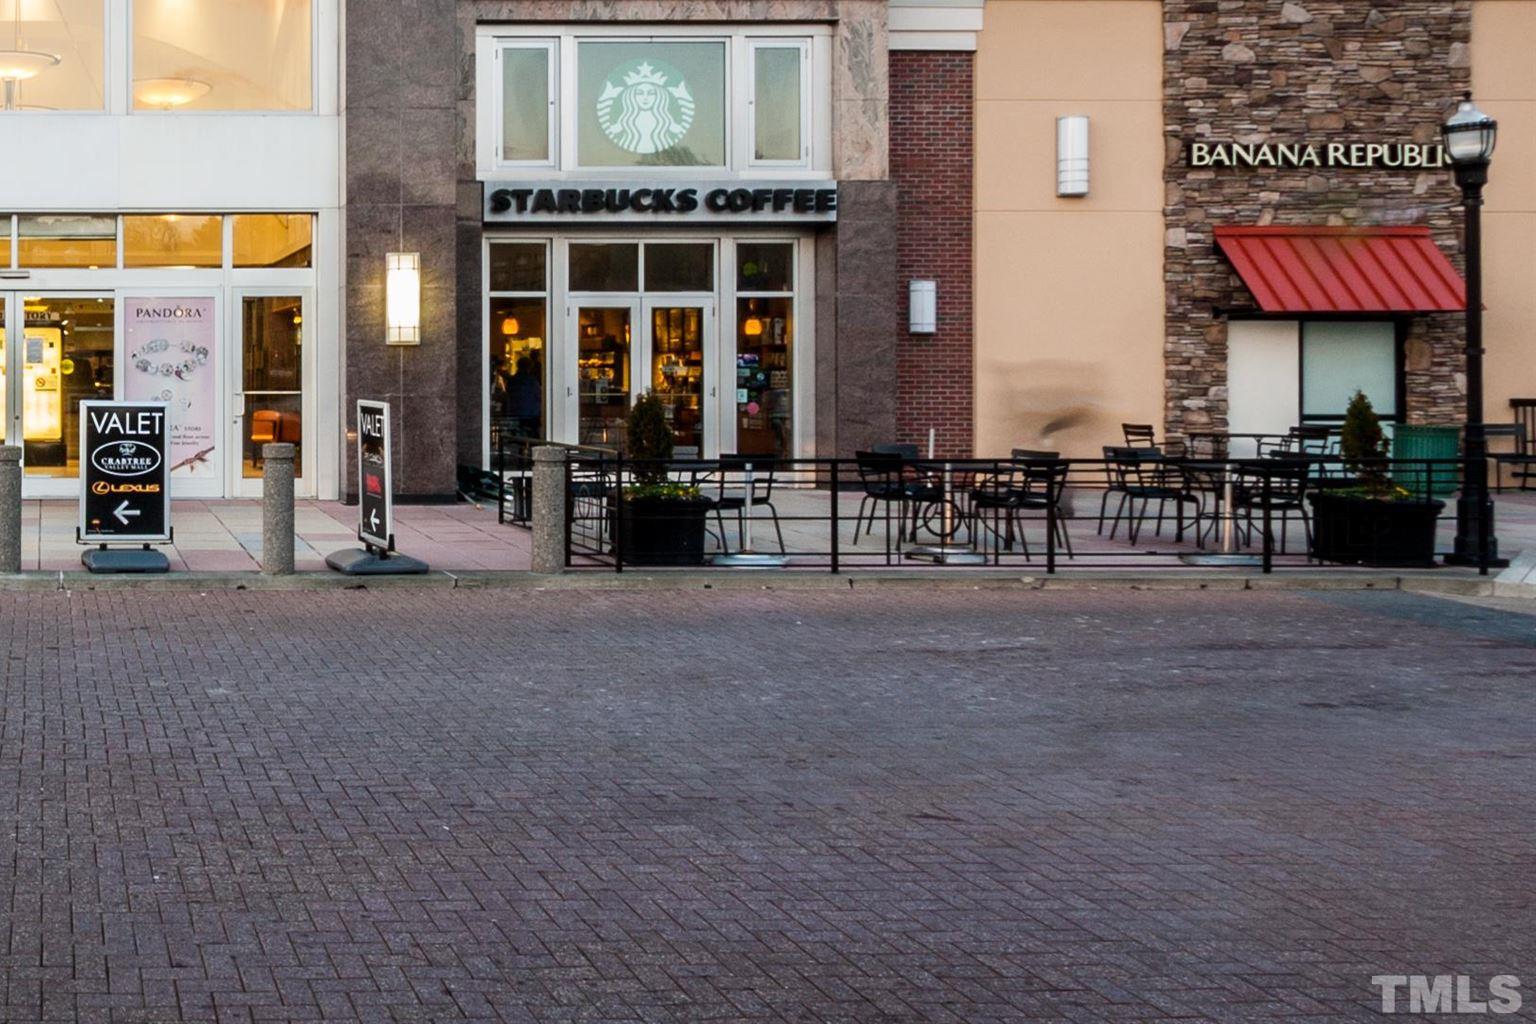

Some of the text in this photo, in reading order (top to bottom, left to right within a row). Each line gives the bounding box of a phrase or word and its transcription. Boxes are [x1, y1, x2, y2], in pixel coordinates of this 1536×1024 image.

[1191, 143, 1452, 167] BANANA REPUBLI
[490, 188, 837, 212] STARBUCKS COFFEE
[90, 412, 163, 435] VALET
[101, 457, 151, 465] CRABTREE
[111, 484, 160, 492] LEXUS
